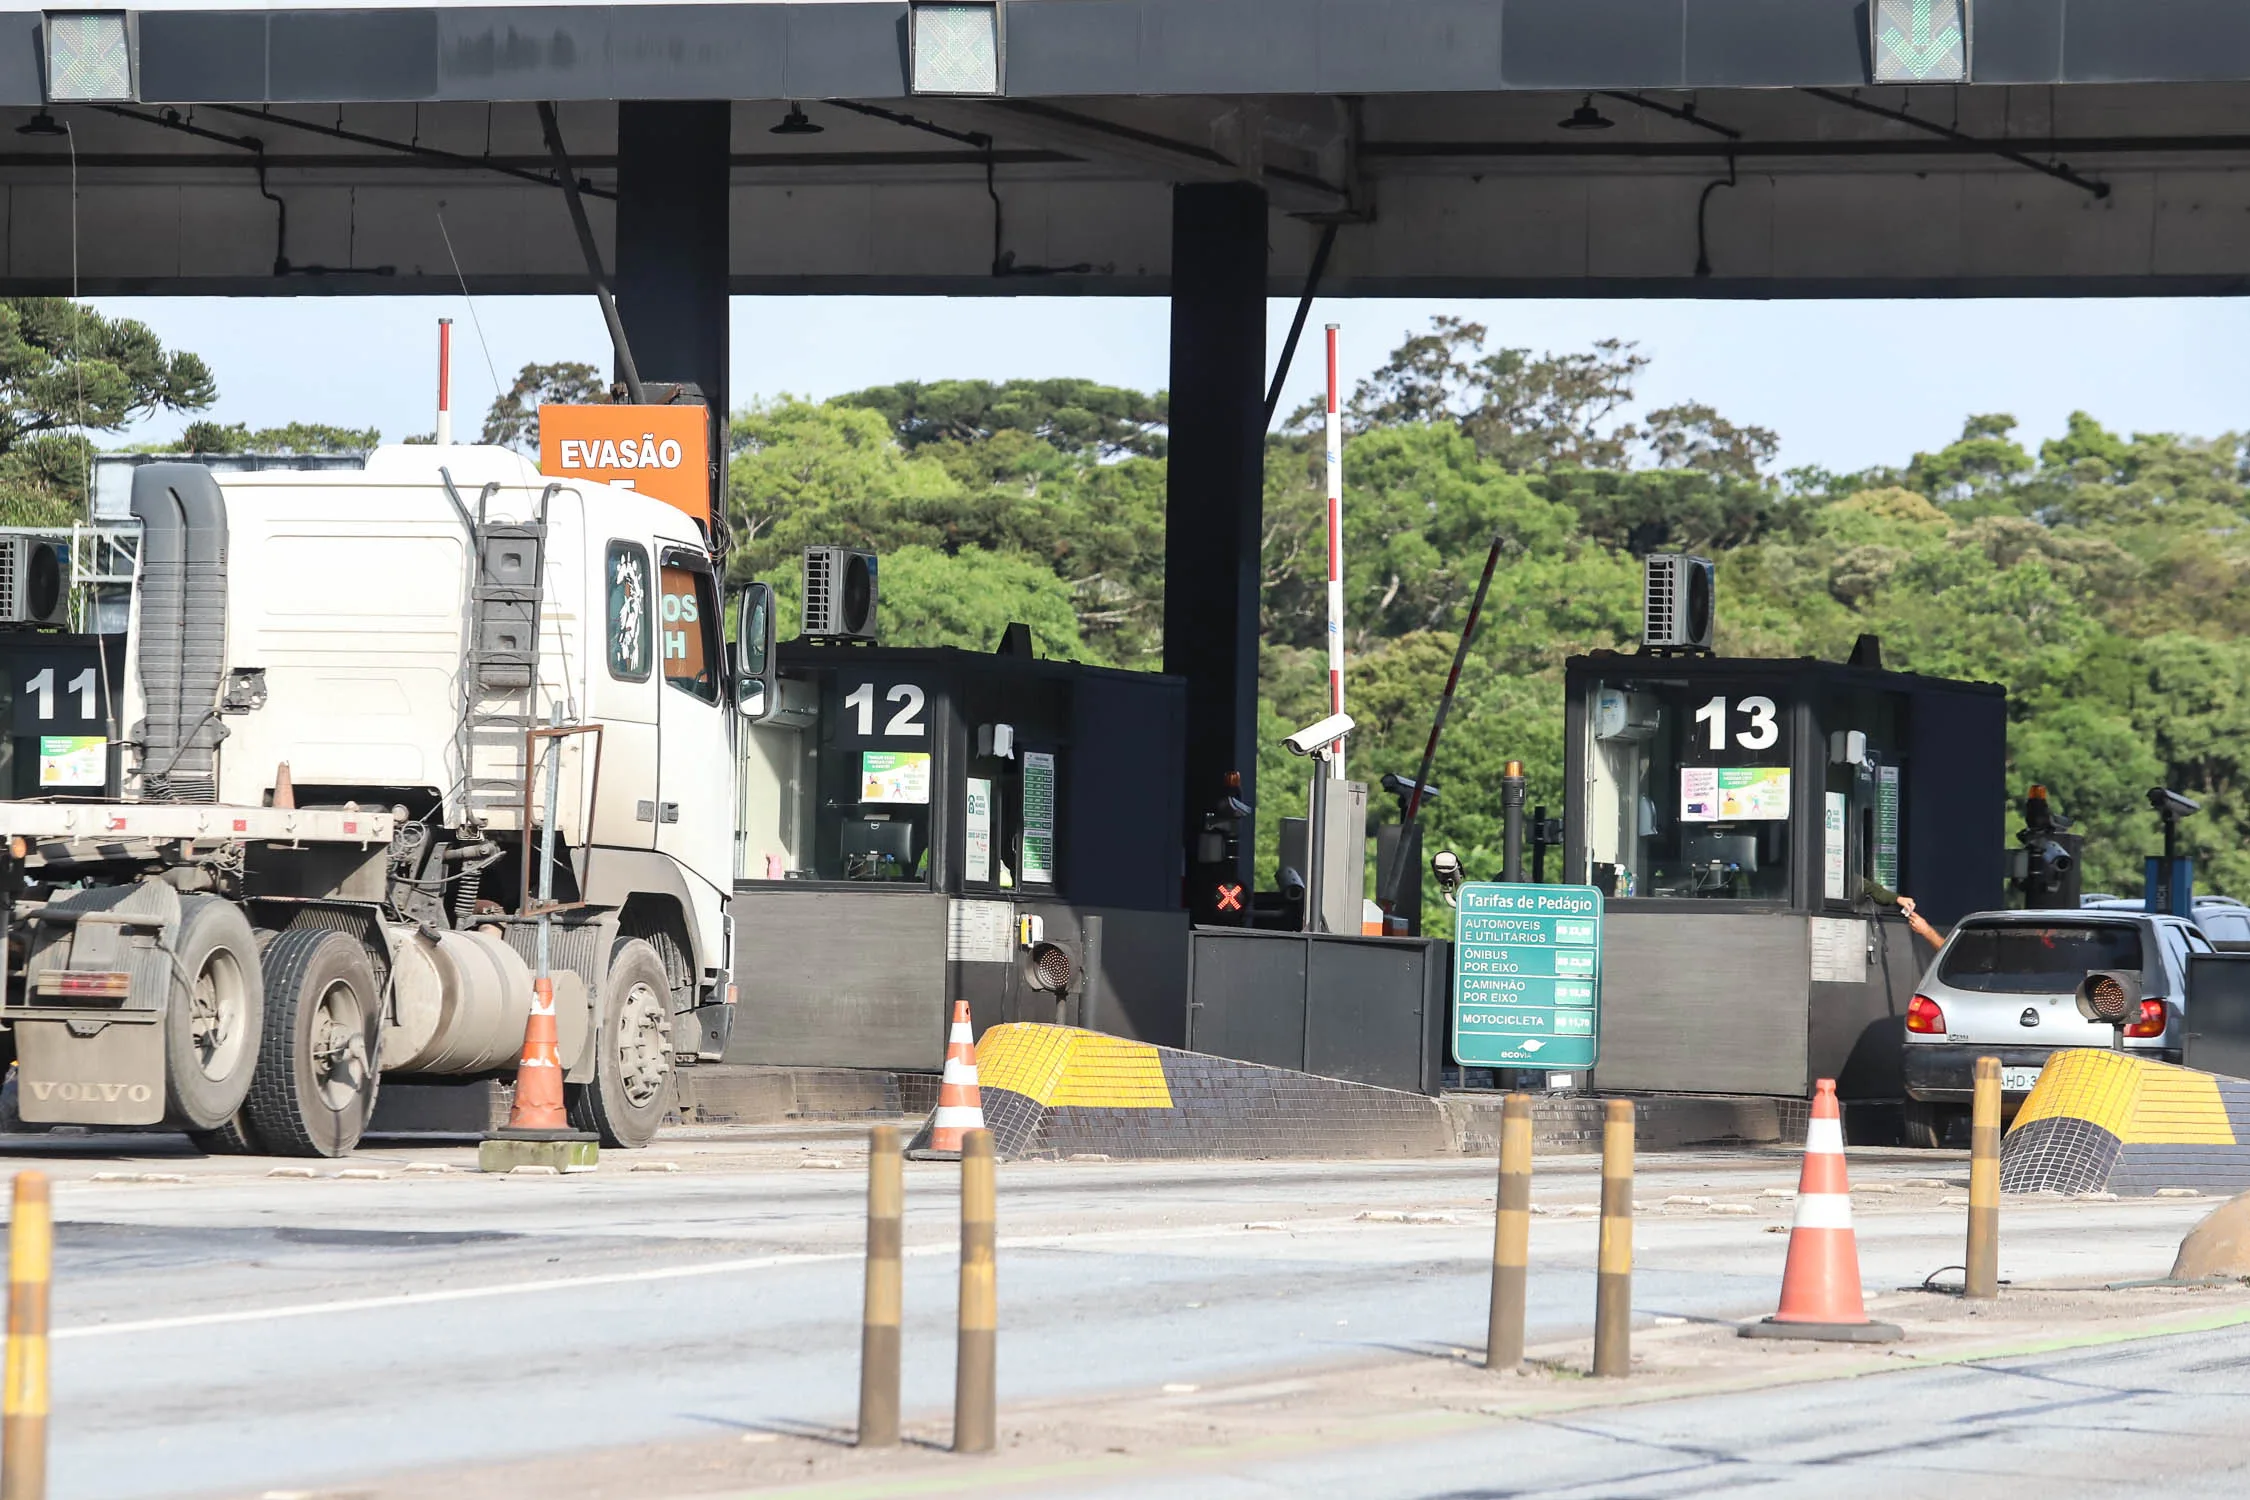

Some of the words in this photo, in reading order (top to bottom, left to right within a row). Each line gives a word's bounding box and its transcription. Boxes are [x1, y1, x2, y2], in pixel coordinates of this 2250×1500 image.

[559, 432, 683, 470] EVASÃO
[25, 667, 97, 720] 11
[844, 682, 926, 737] 12
[1694, 695, 1779, 750] 13
[1466, 893, 1514, 909] Tarifas
[1517, 895, 1534, 909] de
[1537, 896, 1593, 913] Pedágio
[1465, 931, 1472, 941] E
[1464, 947, 1508, 960] ÔNIBUS
[1464, 962, 1489, 972] POR
[1491, 963, 1519, 973] EIXO
[1463, 979, 1526, 991] CAMINHÃO
[1463, 991, 1488, 1002] POR
[1491, 993, 1518, 1003] EIXO
[1462, 1014, 1545, 1026] MOTOCICLETA
[27, 1081, 153, 1102] VOLVO
